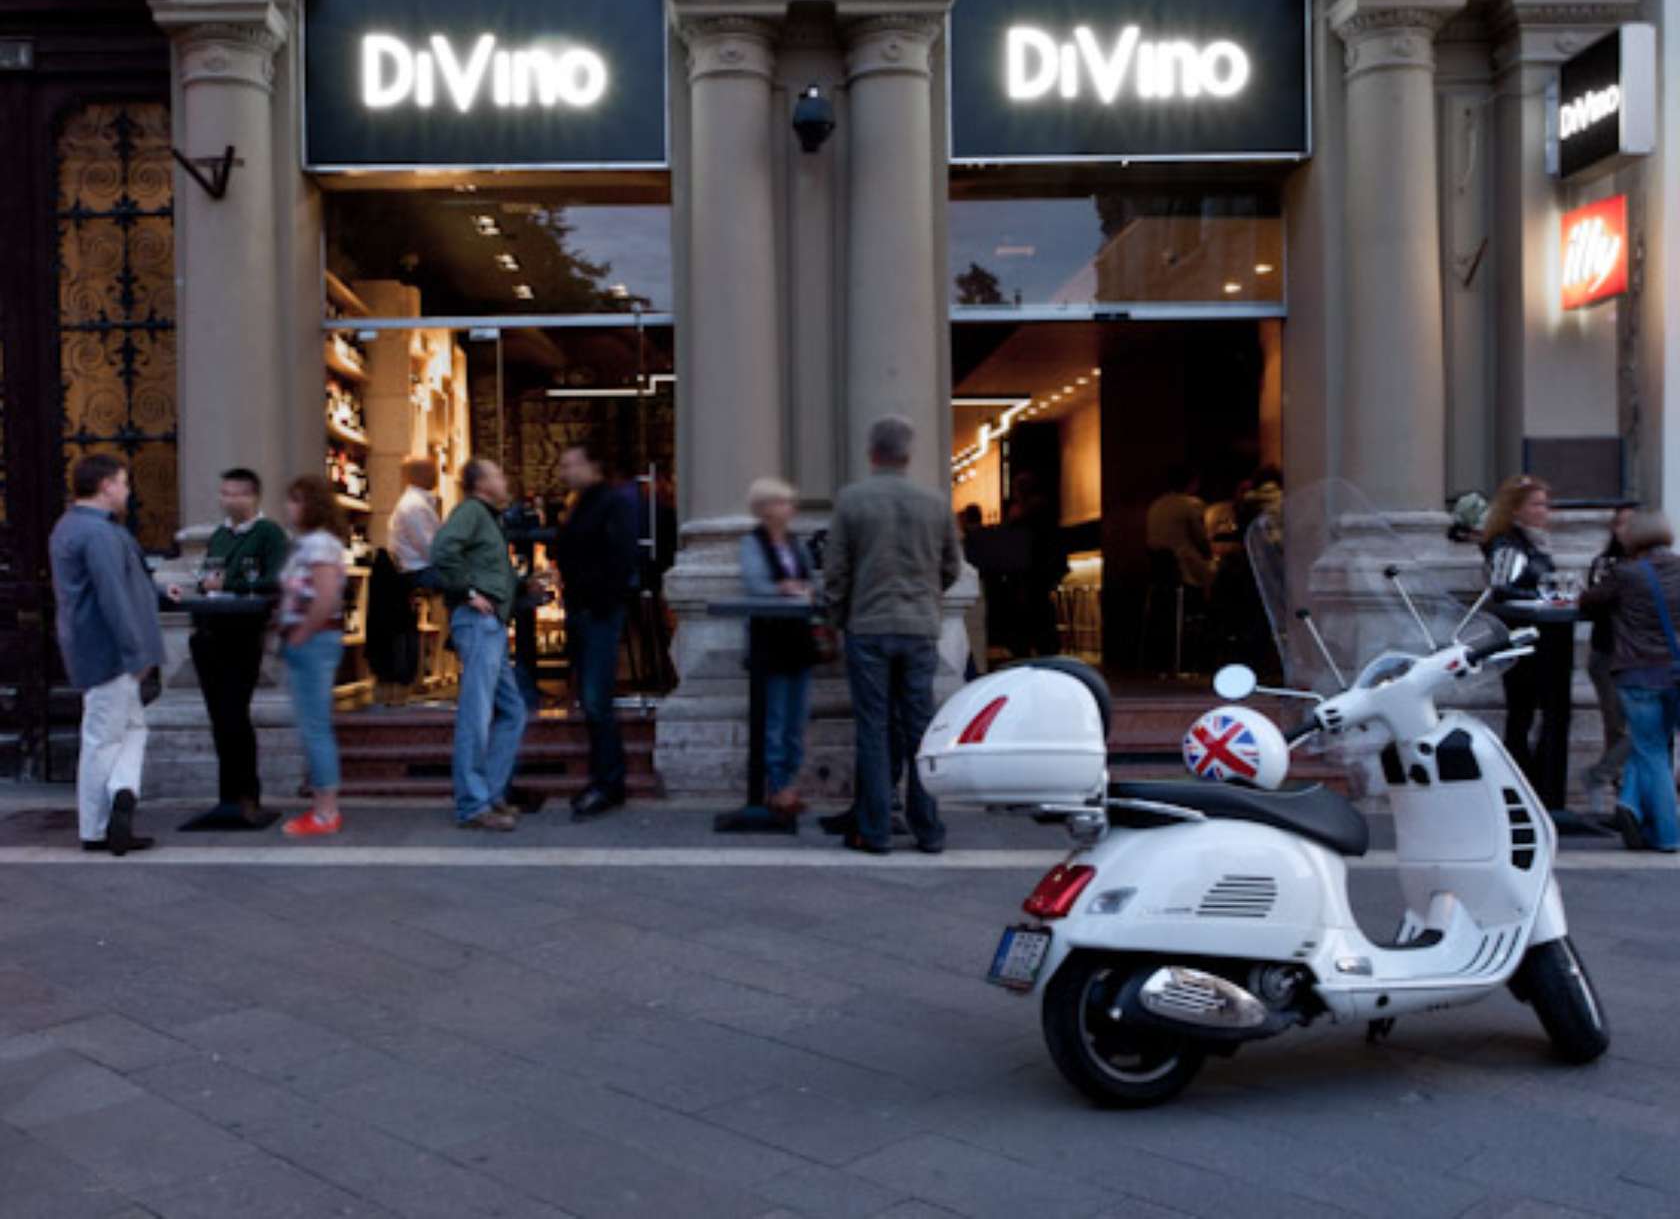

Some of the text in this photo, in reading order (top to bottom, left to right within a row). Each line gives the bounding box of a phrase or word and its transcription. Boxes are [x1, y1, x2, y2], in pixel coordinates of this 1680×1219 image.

[361, 31, 607, 113] DiVino
[1007, 24, 1250, 105] DiVino
[1562, 216, 1621, 293] illy
